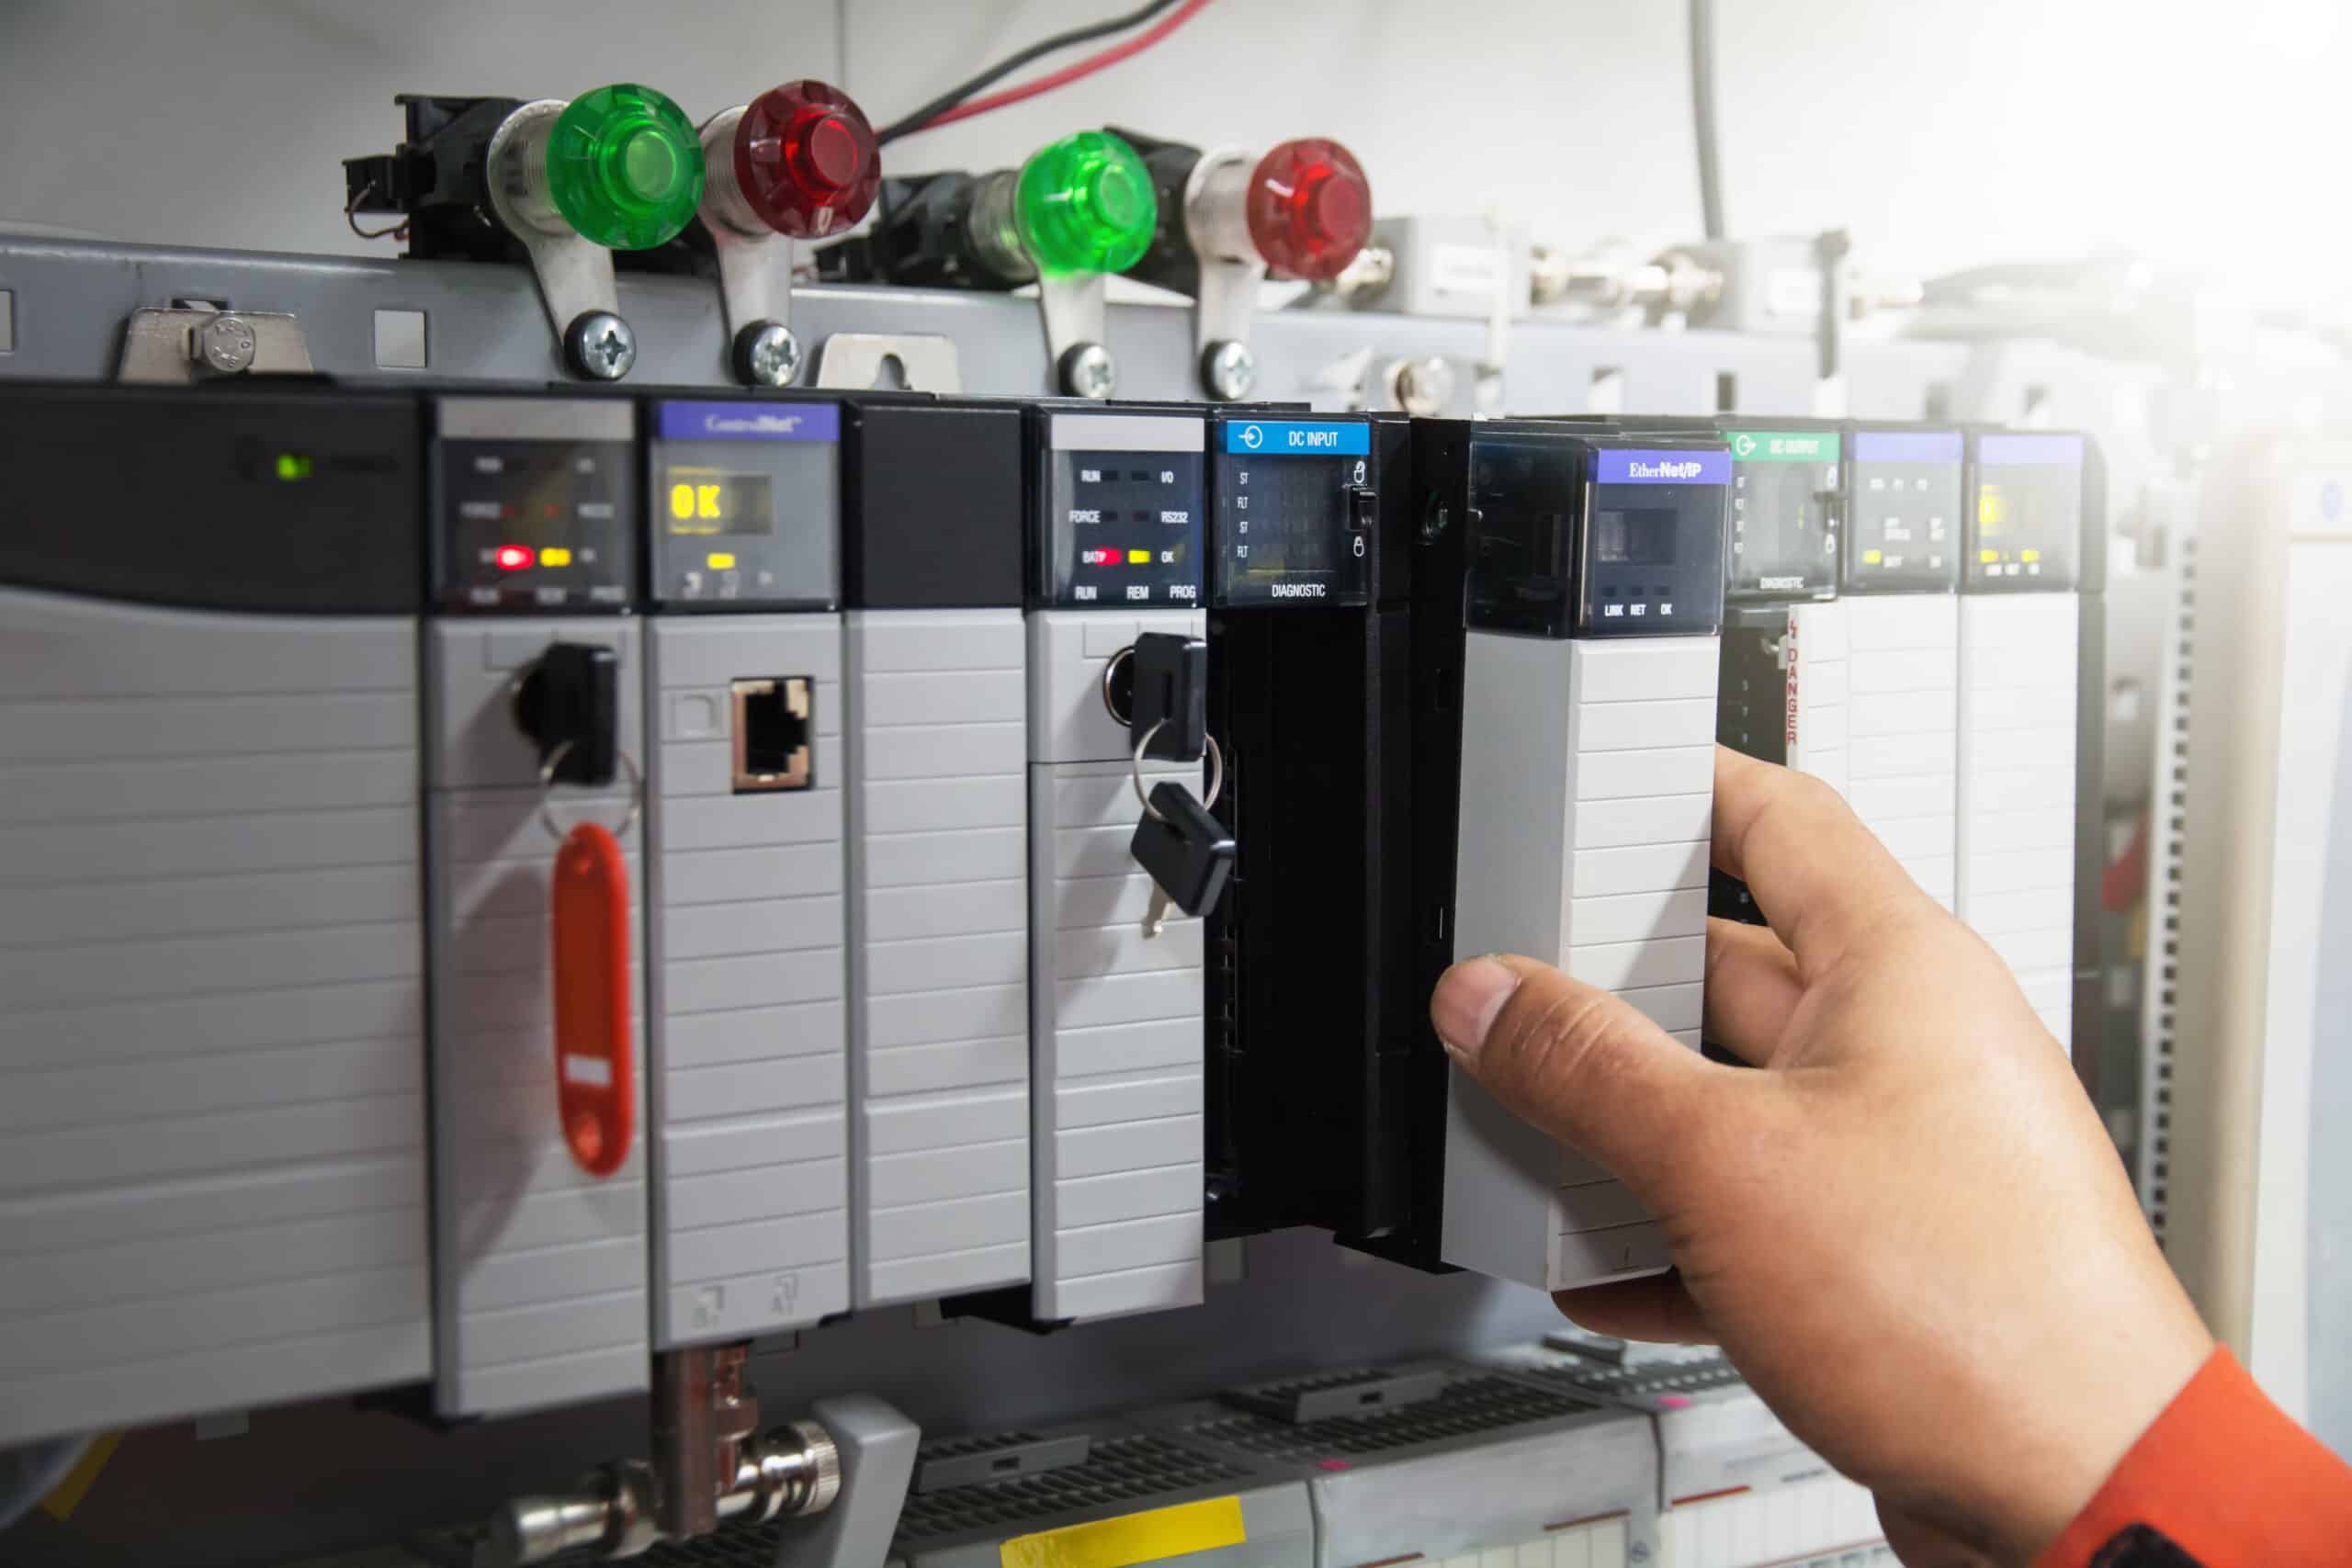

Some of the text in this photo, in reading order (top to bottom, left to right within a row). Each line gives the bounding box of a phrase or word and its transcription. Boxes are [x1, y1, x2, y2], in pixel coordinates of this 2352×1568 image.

[1289, 431, 1338, 446] DC INPUT
[1081, 469, 1101, 482] RUN
[1161, 470, 1174, 483] I/O
[1629, 462, 1702, 479] EtherNet/IP
[671, 484, 721, 519] OK
[1069, 510, 1101, 524] FORCE
[1161, 511, 1188, 524] RS232
[1161, 551, 1174, 563] OK
[1075, 586, 1097, 600] RUN
[1126, 586, 1149, 600] REM
[1170, 586, 1196, 599] PROG
[1272, 584, 1326, 598] DIAGNOSTIC
[1605, 604, 1672, 616] LINK NET OK
[1787, 647, 1798, 745] DANGER
